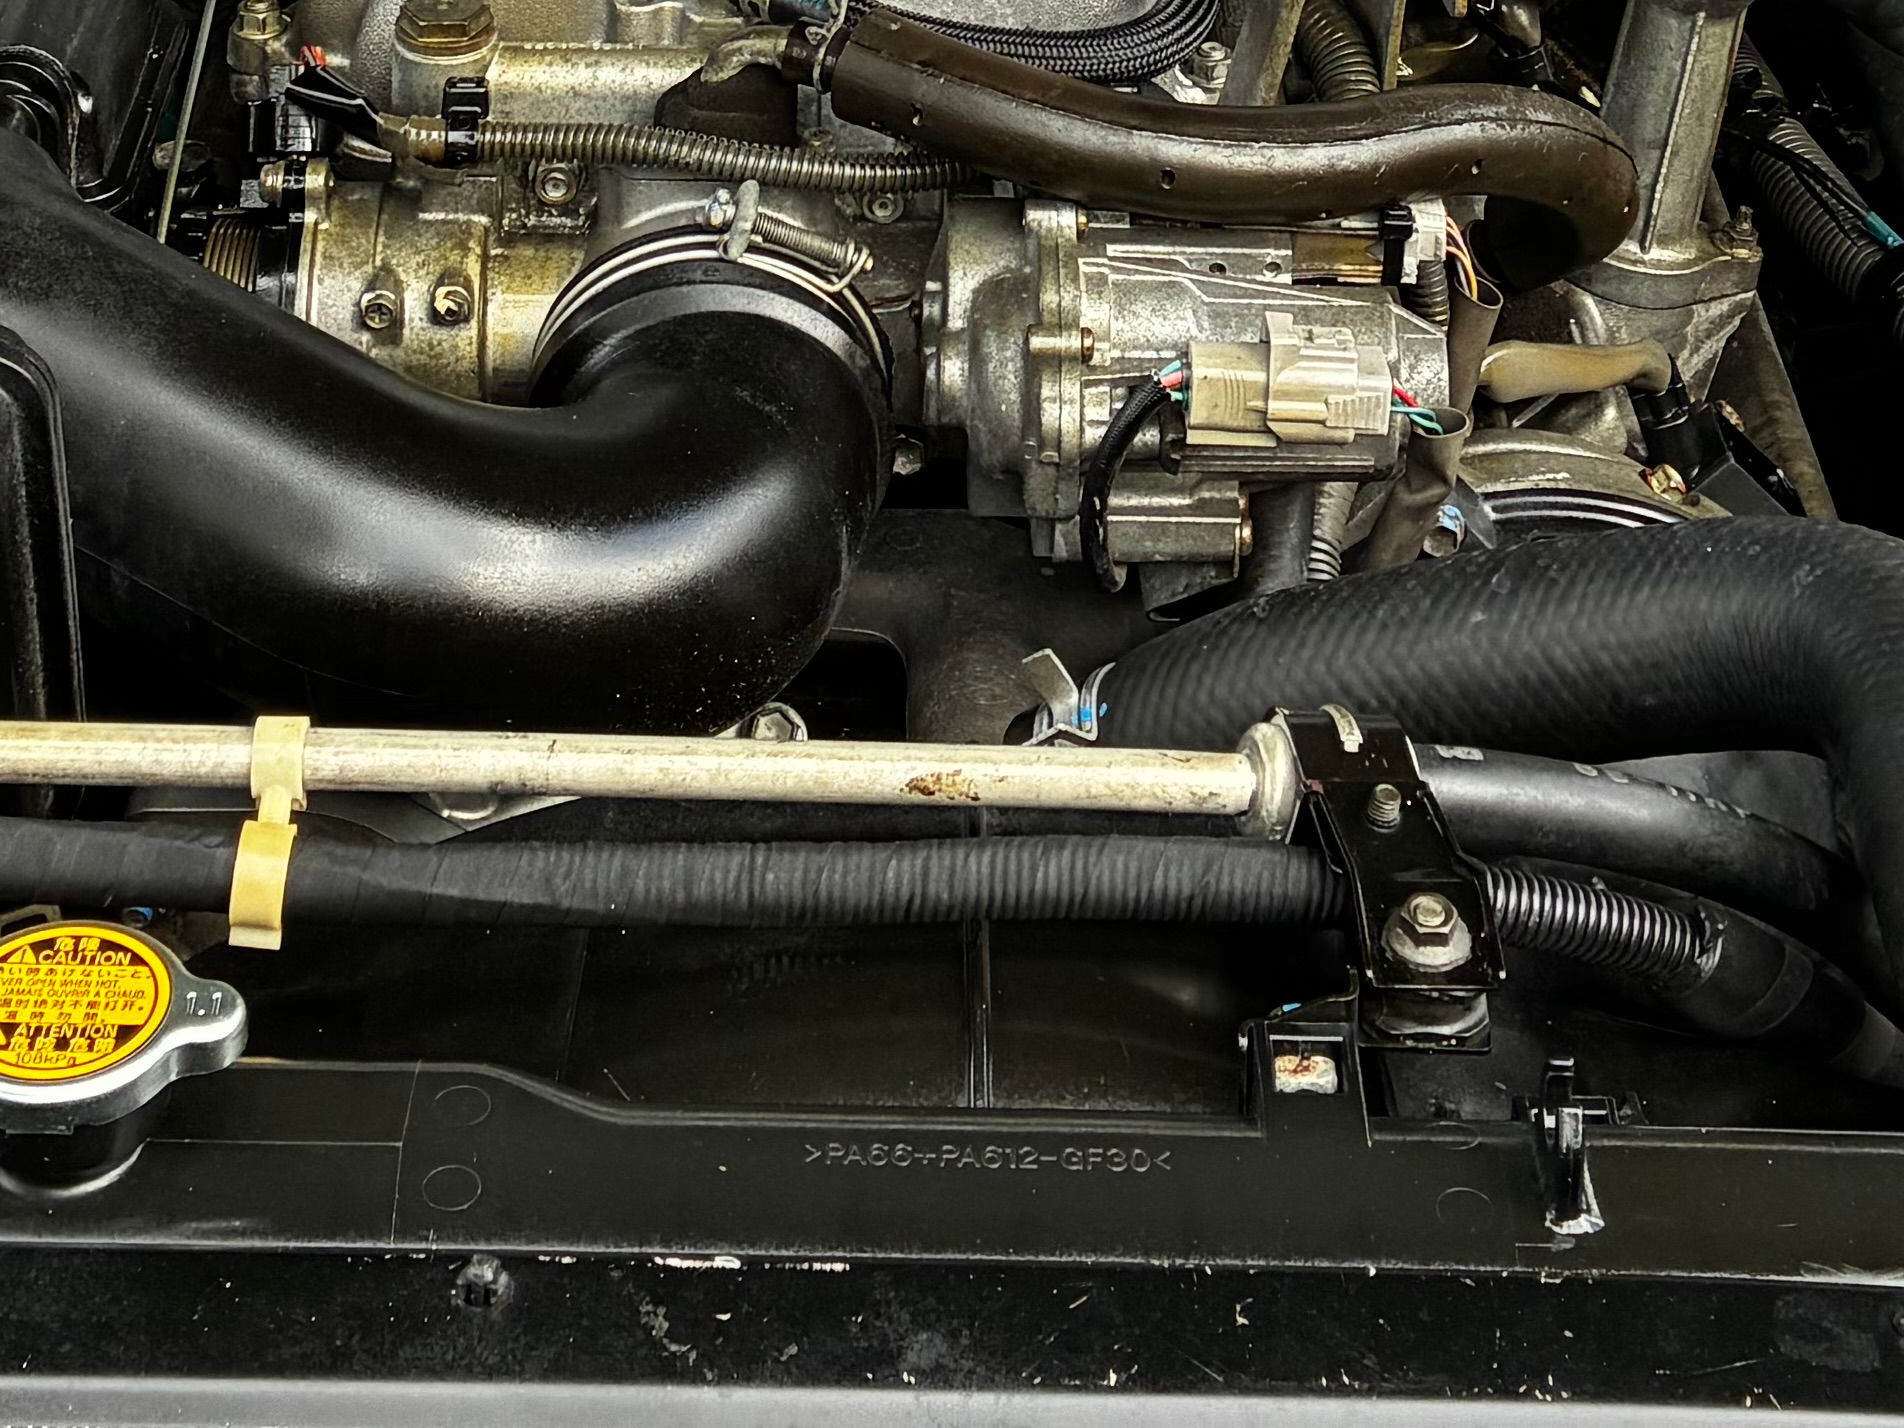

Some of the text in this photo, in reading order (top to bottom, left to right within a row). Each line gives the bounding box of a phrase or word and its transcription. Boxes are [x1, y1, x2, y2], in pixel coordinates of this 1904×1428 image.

[38, 950, 133, 966] CAUTION
[26, 978, 56, 989] OPEN
[59, 979, 92, 989] WHEN
[95, 980, 122, 990] HOT.
[3, 987, 43, 997] JAMAIS
[46, 988, 91, 998] OUVRIR
[104, 990, 147, 1000] CHAUD.
[184, 990, 223, 1018] 1.1
[13, 1024, 119, 1040] ATTENTION
[14, 1052, 80, 1066] 108kPa
[803, 1141, 1172, 1174] >PA66+PA612-GF30<
